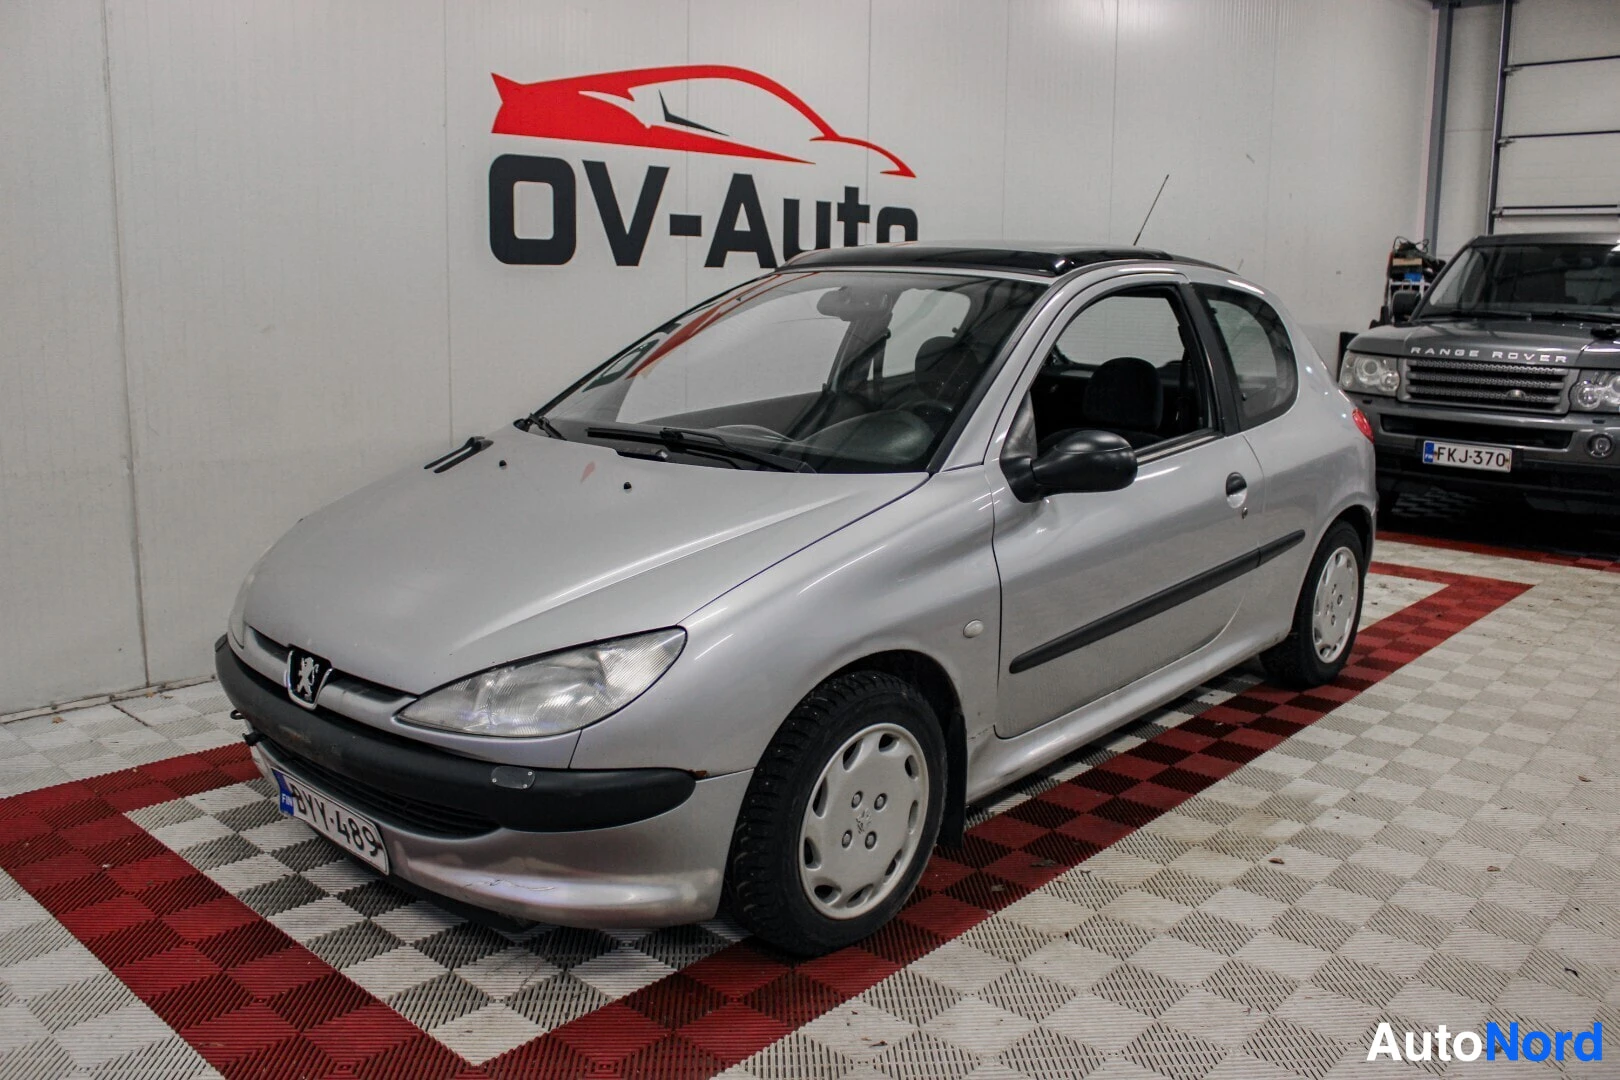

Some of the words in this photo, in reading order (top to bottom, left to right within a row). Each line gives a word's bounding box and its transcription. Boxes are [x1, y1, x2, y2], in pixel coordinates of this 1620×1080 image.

[1410, 347, 1479, 357] RANGE
[1492, 351, 1567, 363] ROVER
[1436, 447, 1506, 467] FKJ-370
